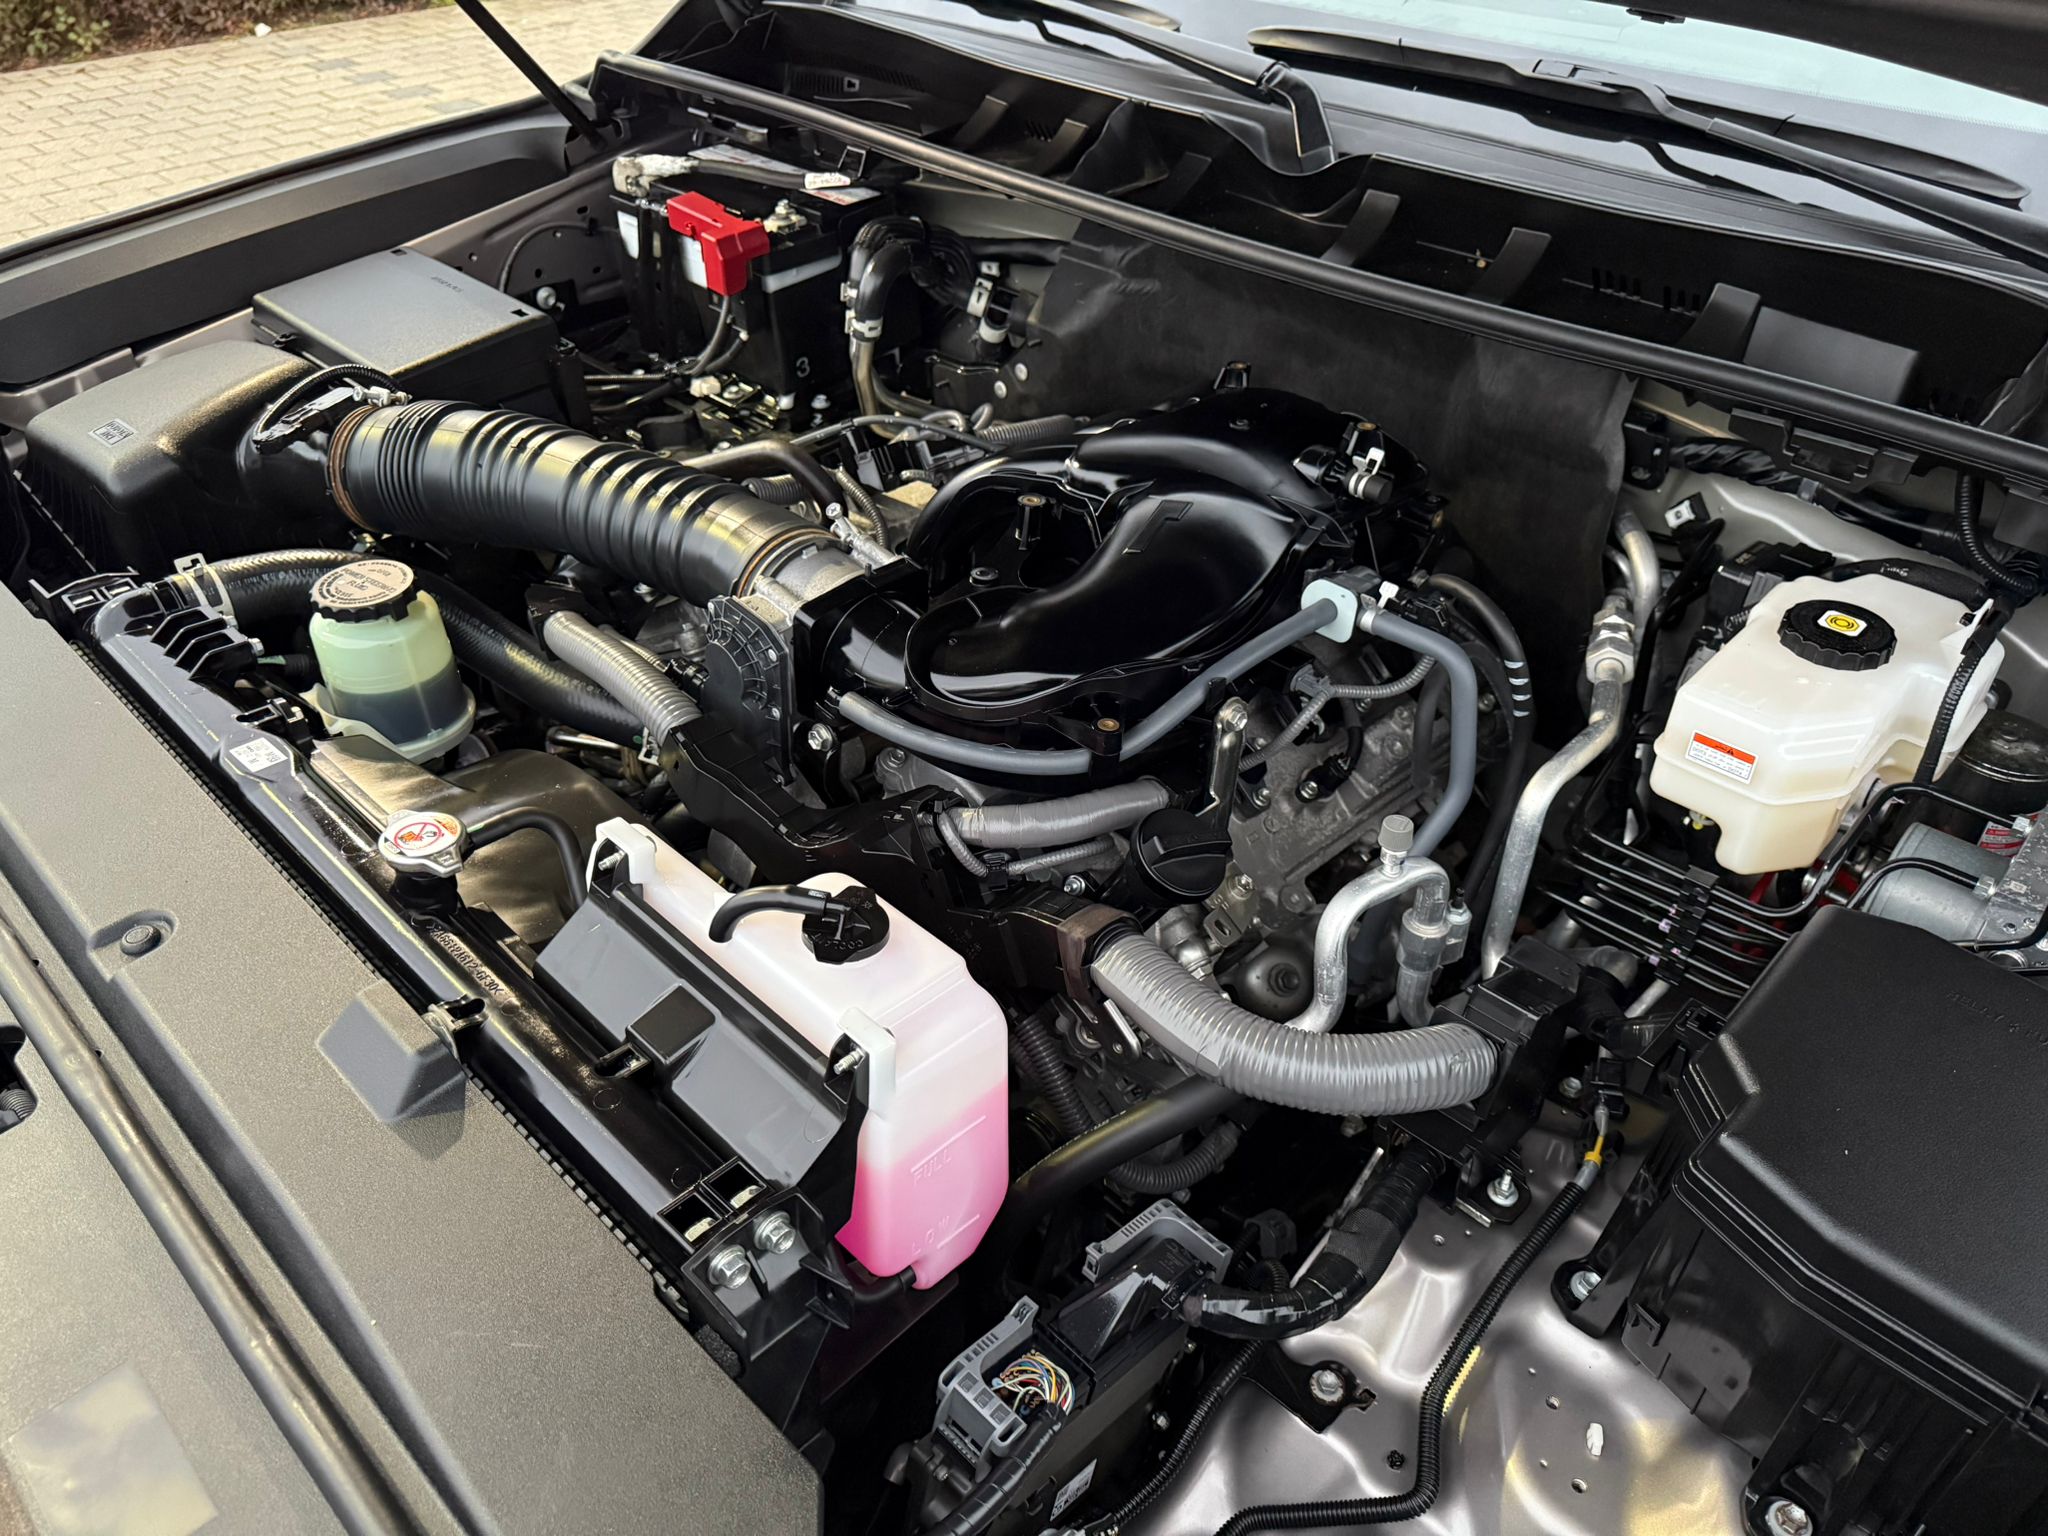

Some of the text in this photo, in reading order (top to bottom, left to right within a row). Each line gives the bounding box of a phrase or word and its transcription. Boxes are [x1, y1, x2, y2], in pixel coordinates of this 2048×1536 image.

[796, 357, 810, 378] 3
[913, 1149, 952, 1185] FULL
[911, 1215, 950, 1255] LOW
